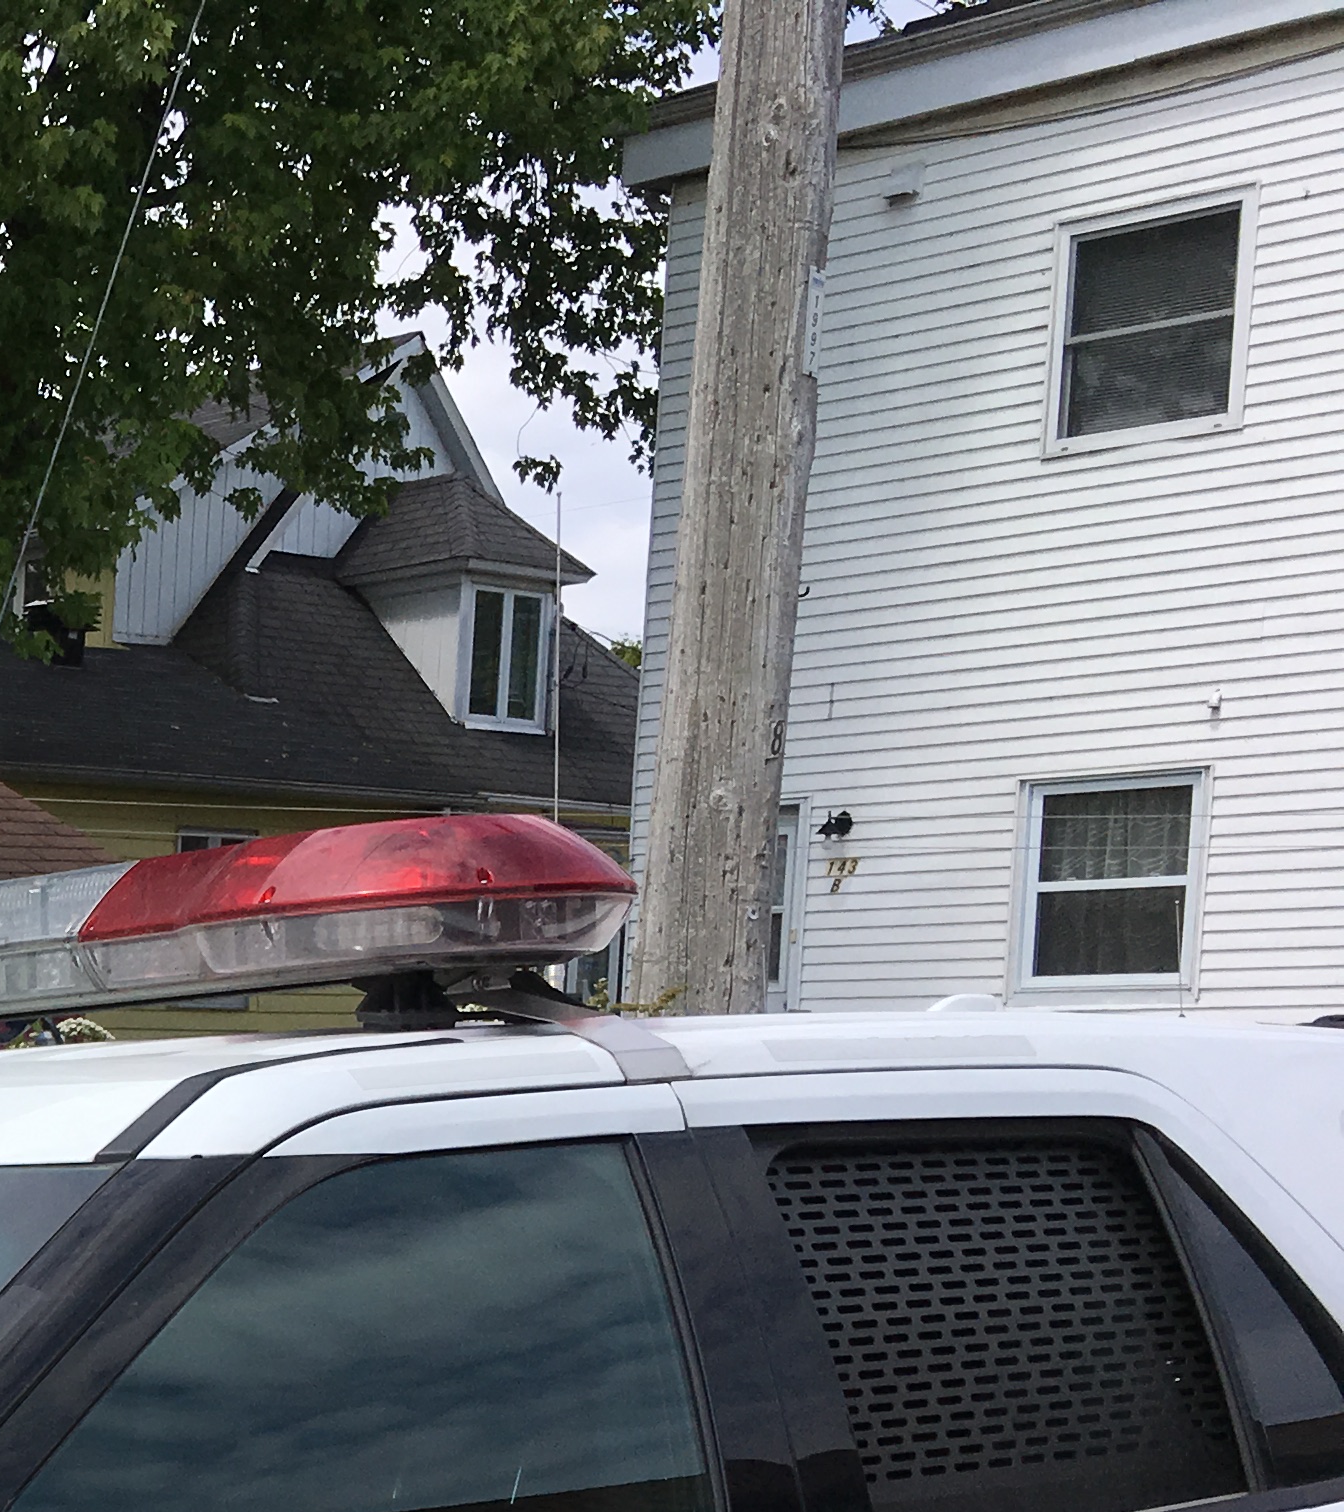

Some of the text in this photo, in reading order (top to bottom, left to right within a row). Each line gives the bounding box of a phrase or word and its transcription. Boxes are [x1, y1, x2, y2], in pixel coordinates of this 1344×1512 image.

[808, 295, 820, 366] 1997
[826, 858, 859, 877] 143
[830, 878, 842, 893] B
